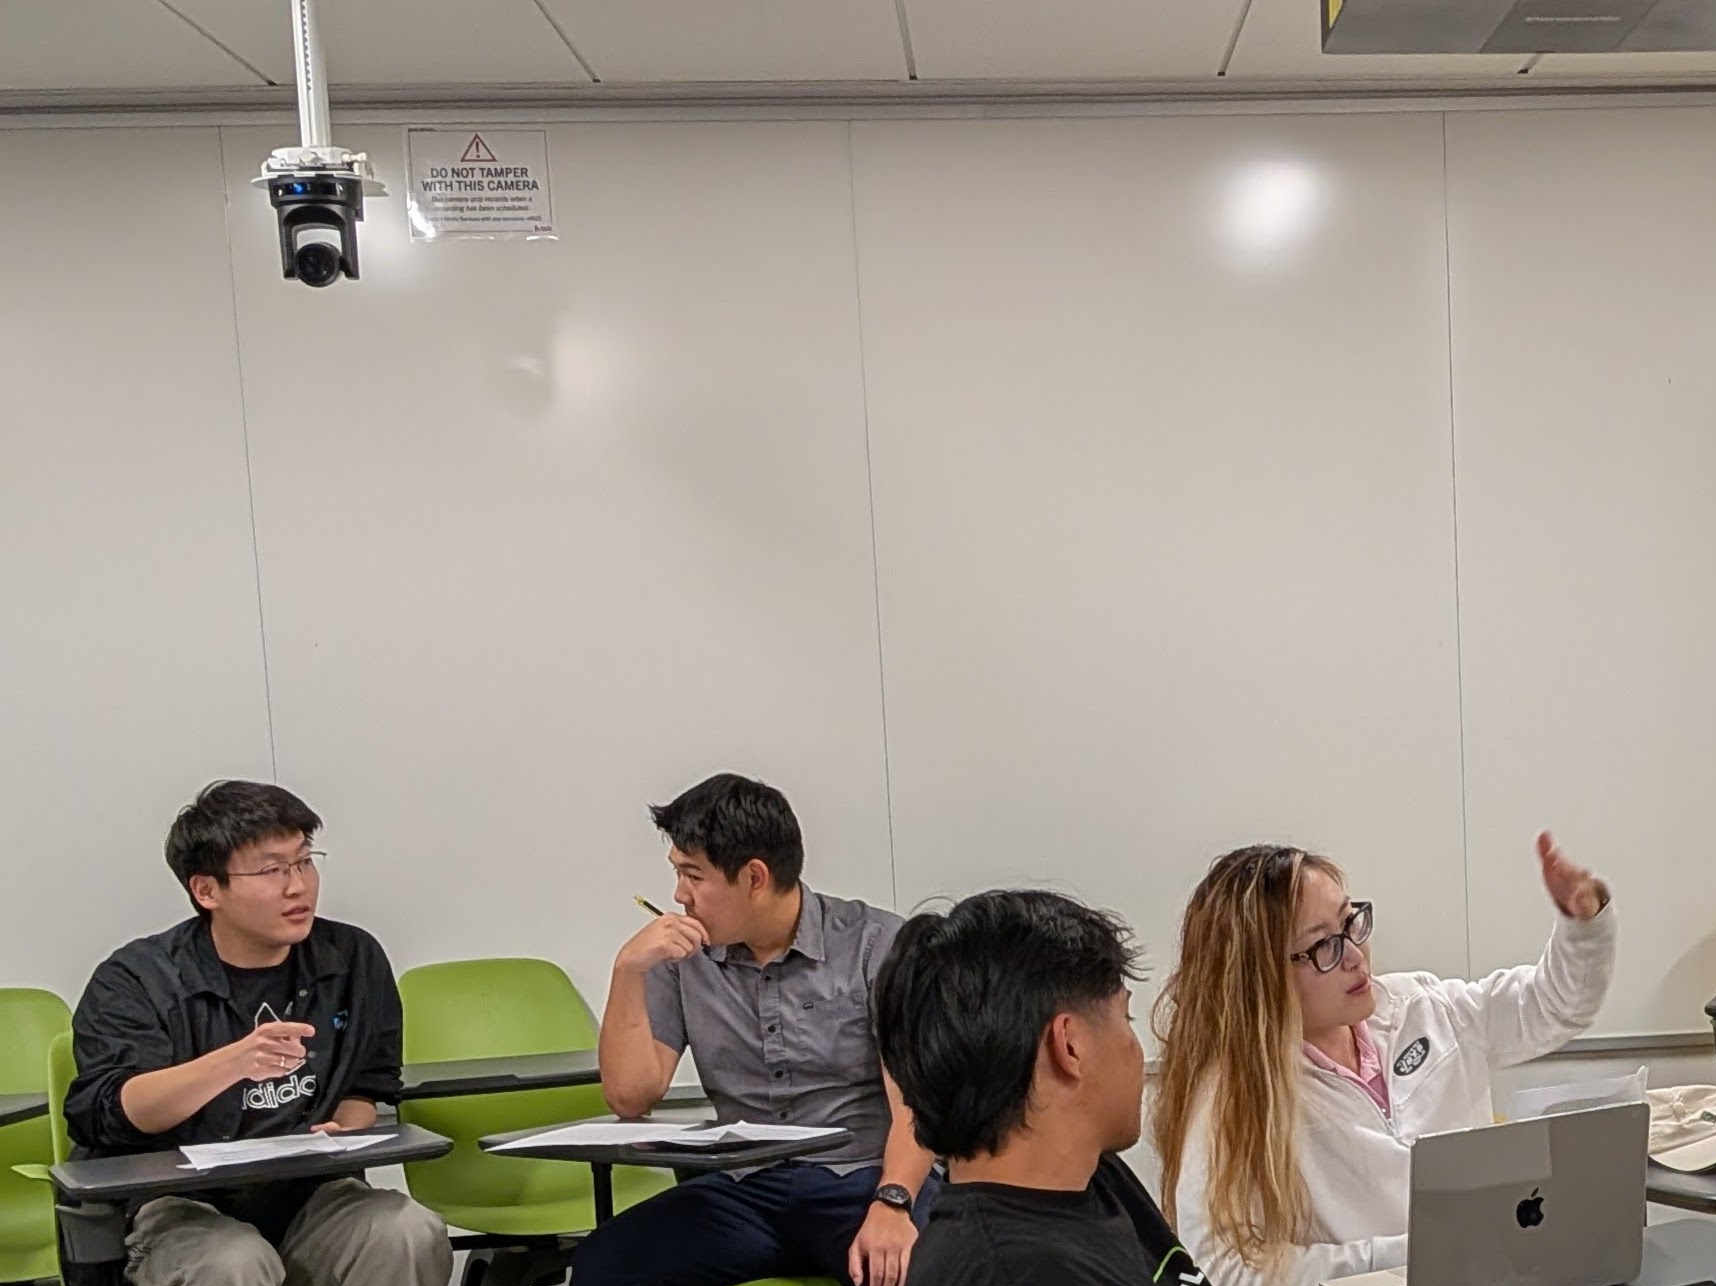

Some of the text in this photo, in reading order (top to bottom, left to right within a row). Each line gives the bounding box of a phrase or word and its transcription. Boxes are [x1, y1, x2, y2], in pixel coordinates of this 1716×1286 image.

[430, 167, 529, 178] DO NOT TAMPER
[421, 180, 540, 192] WITH THIS CAMERA
